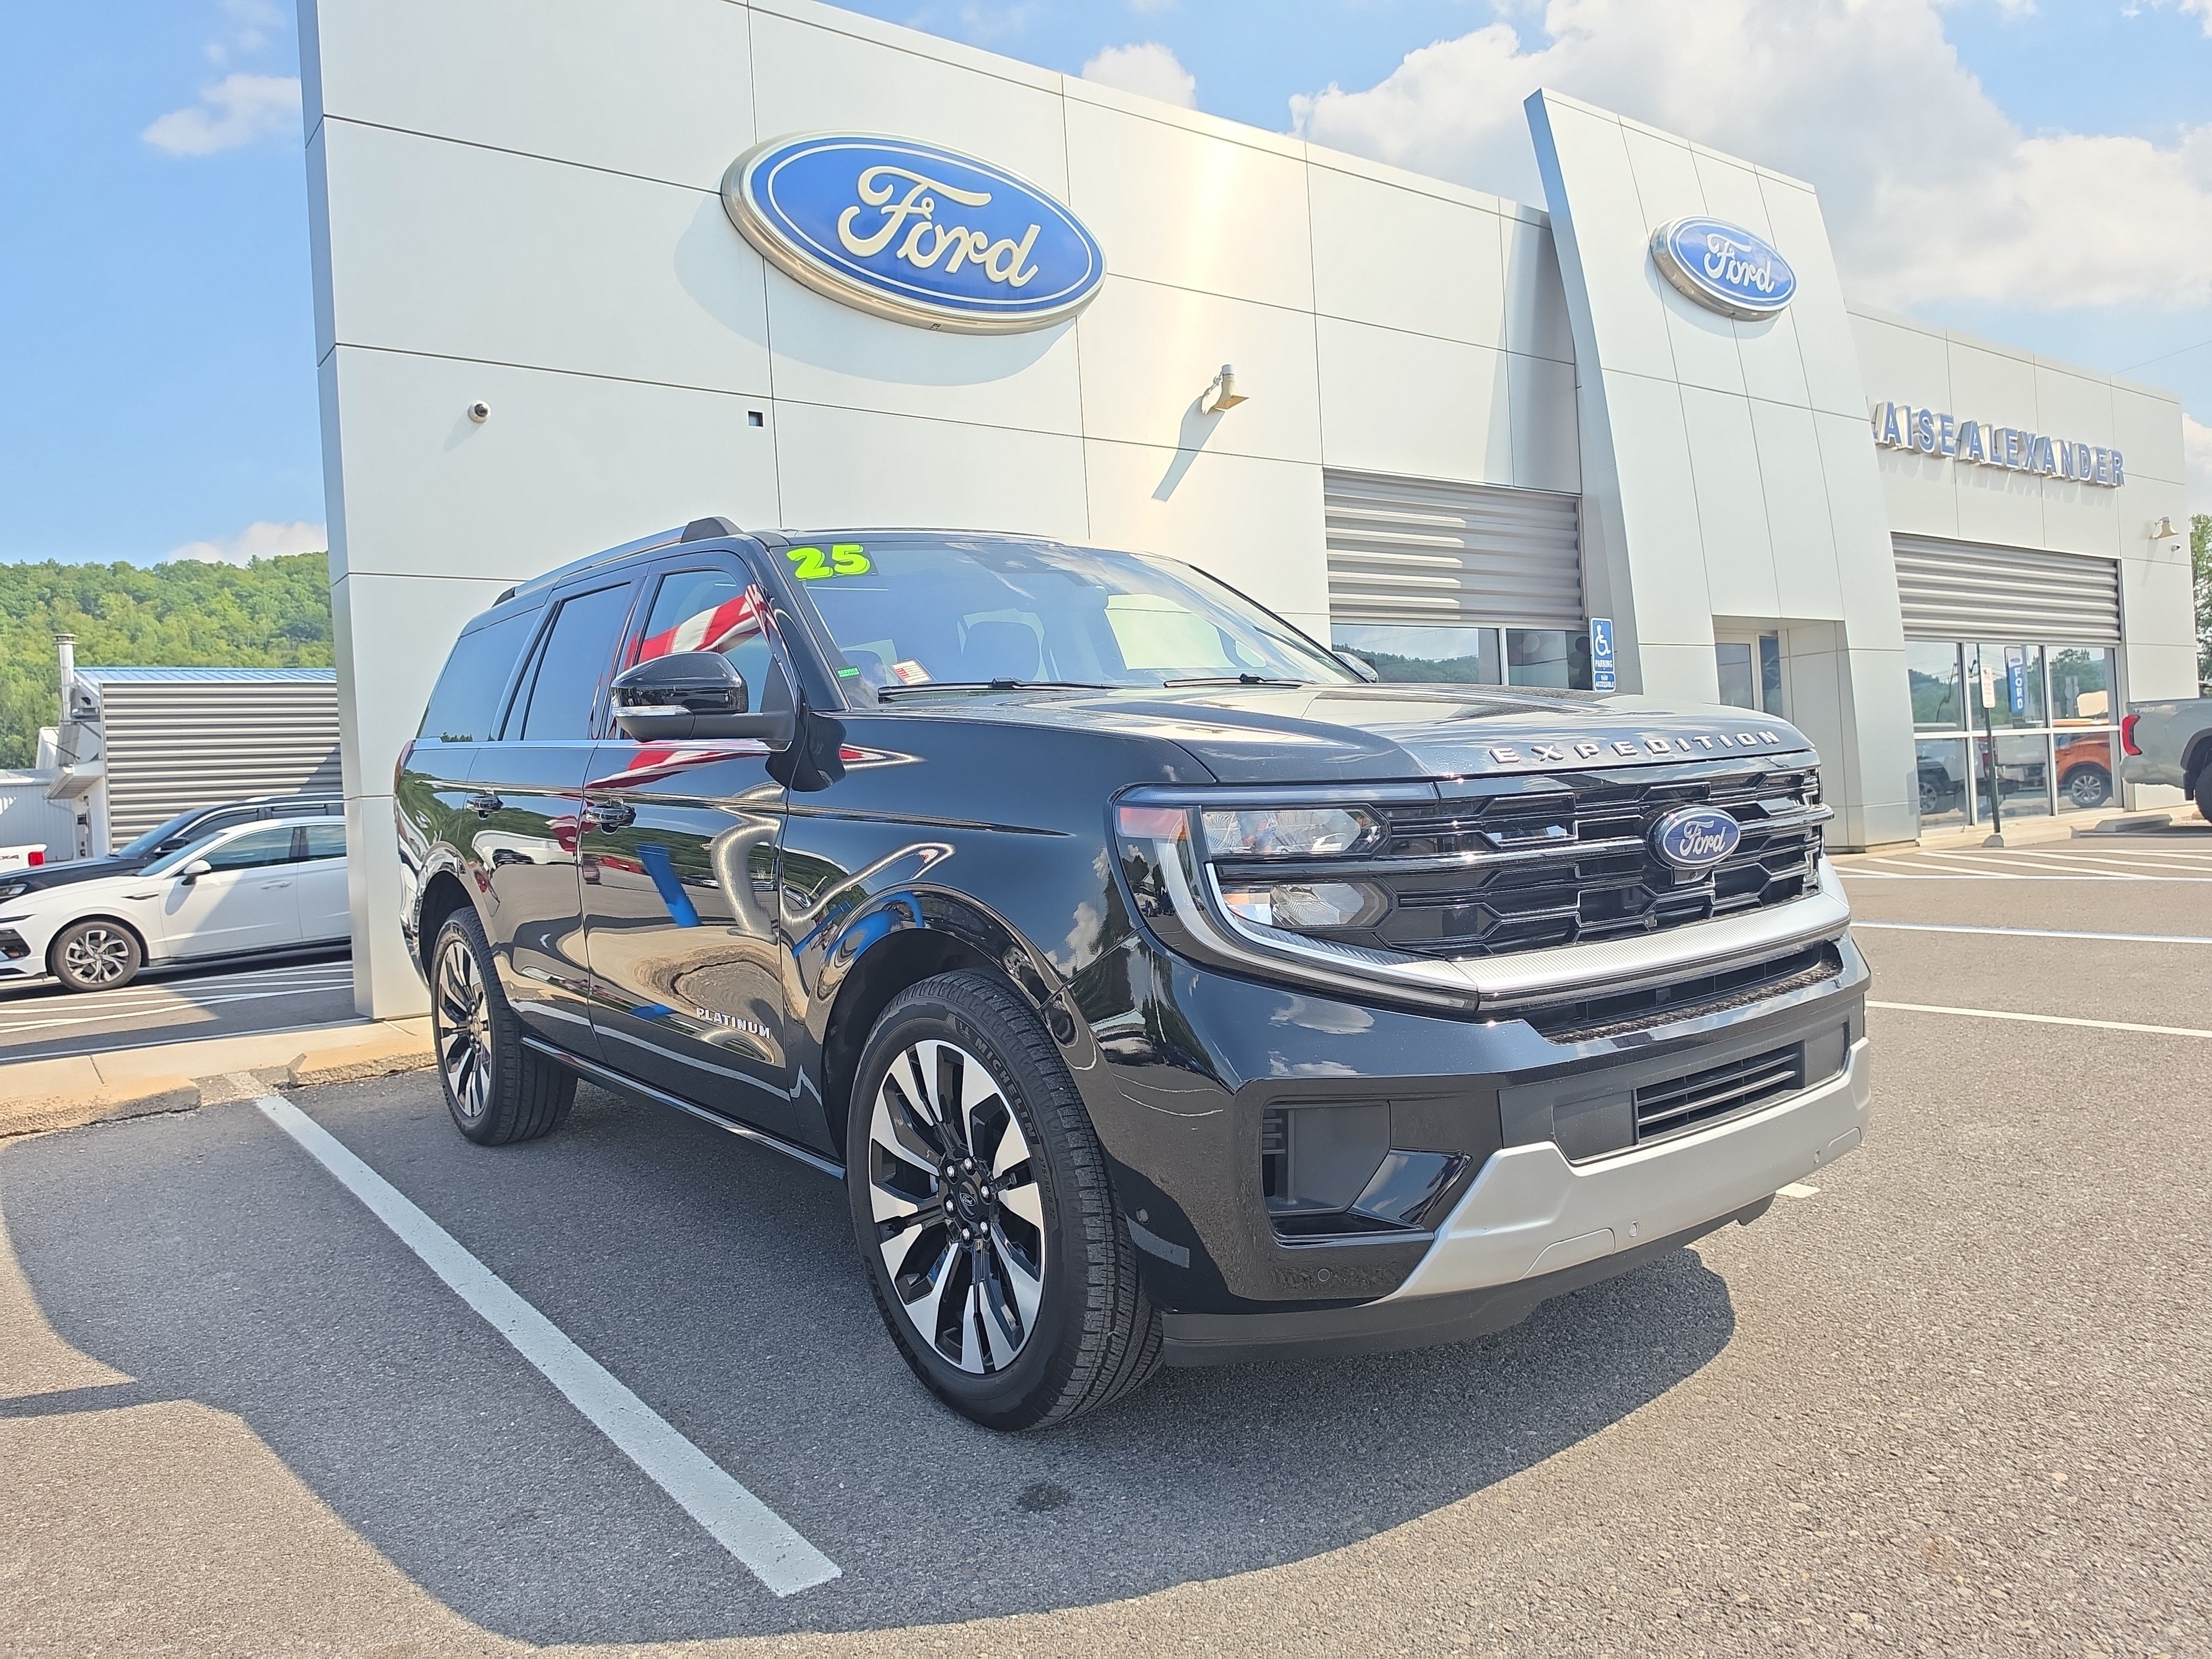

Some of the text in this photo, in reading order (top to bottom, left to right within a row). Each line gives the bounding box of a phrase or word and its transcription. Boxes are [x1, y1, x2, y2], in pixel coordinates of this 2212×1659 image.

[838, 166, 1040, 288] Ford
[1704, 233, 1774, 293] Ford
[1874, 402, 2125, 487] AISE ALEXANDER
[787, 544, 870, 579] 25
[1595, 659, 1612, 668] PARKING
[2014, 667, 2023, 709] FORD
[1489, 730, 1780, 764] EXPEDITION
[1680, 820, 1726, 857] Ford
[696, 1007, 771, 1039] PLATINUM
[975, 1037, 1036, 1137] MICHELIN
[962, 1194, 973, 1205] Ford
[1038, 1156, 1051, 1193] 275/50
[1050, 1207, 1056, 1219] 22
